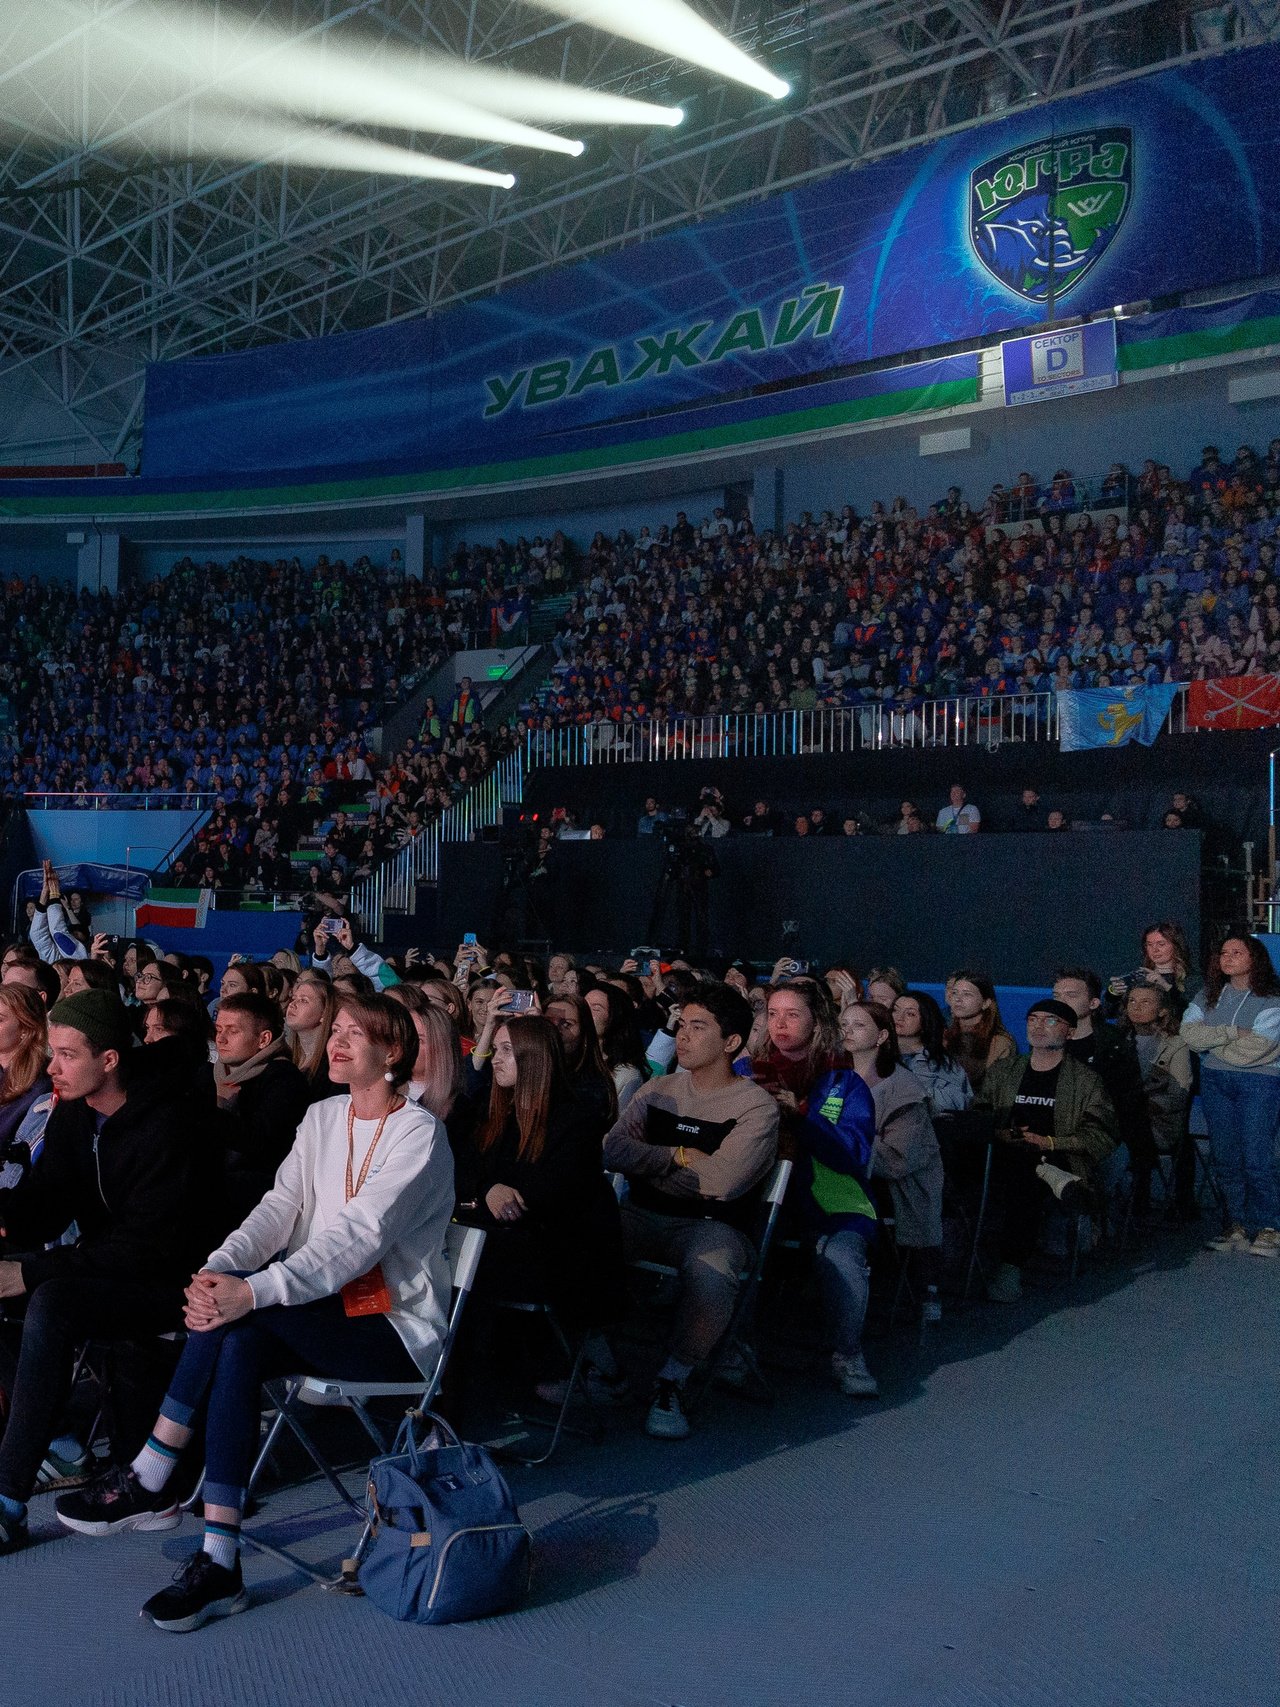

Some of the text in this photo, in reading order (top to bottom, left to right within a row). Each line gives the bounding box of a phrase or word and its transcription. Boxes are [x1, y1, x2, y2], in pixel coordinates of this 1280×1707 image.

[483, 282, 844, 420] УВАЖАЙ
[1034, 332, 1080, 350] СЕКТОР
[1046, 347, 1068, 372] D
[676, 1123, 700, 1134] ermit
